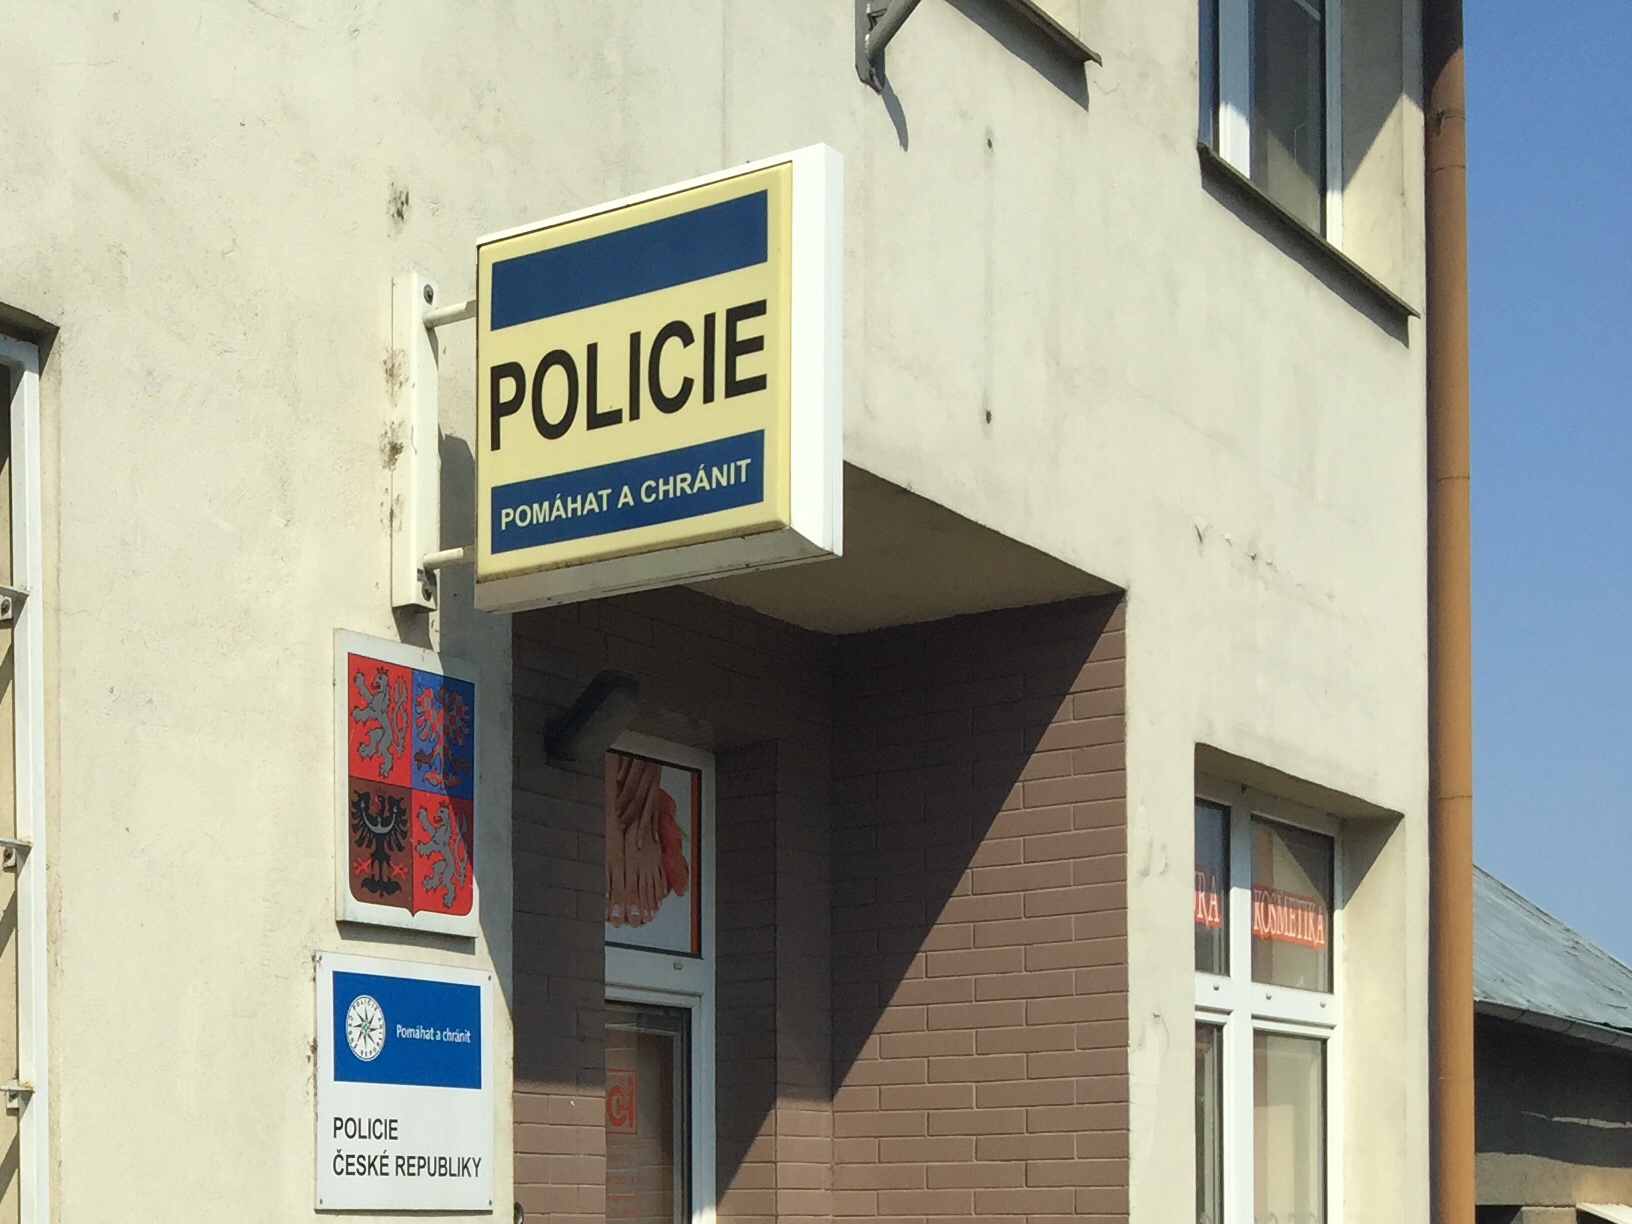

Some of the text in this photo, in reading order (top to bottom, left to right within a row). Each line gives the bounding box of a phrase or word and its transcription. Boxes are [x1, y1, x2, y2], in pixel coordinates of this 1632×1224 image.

[490, 298, 767, 452] POLICIE
[501, 458, 752, 530] POMÁHAT A CHRÁNIT
[1194, 871, 1220, 926] RA
[1253, 888, 1326, 945] KOSMETIKA
[396, 1023, 471, 1043] Pomáhat a chránit
[333, 1116, 399, 1140] POLICIE
[333, 1148, 482, 1178] ČESKÉ REPUBLIKY
